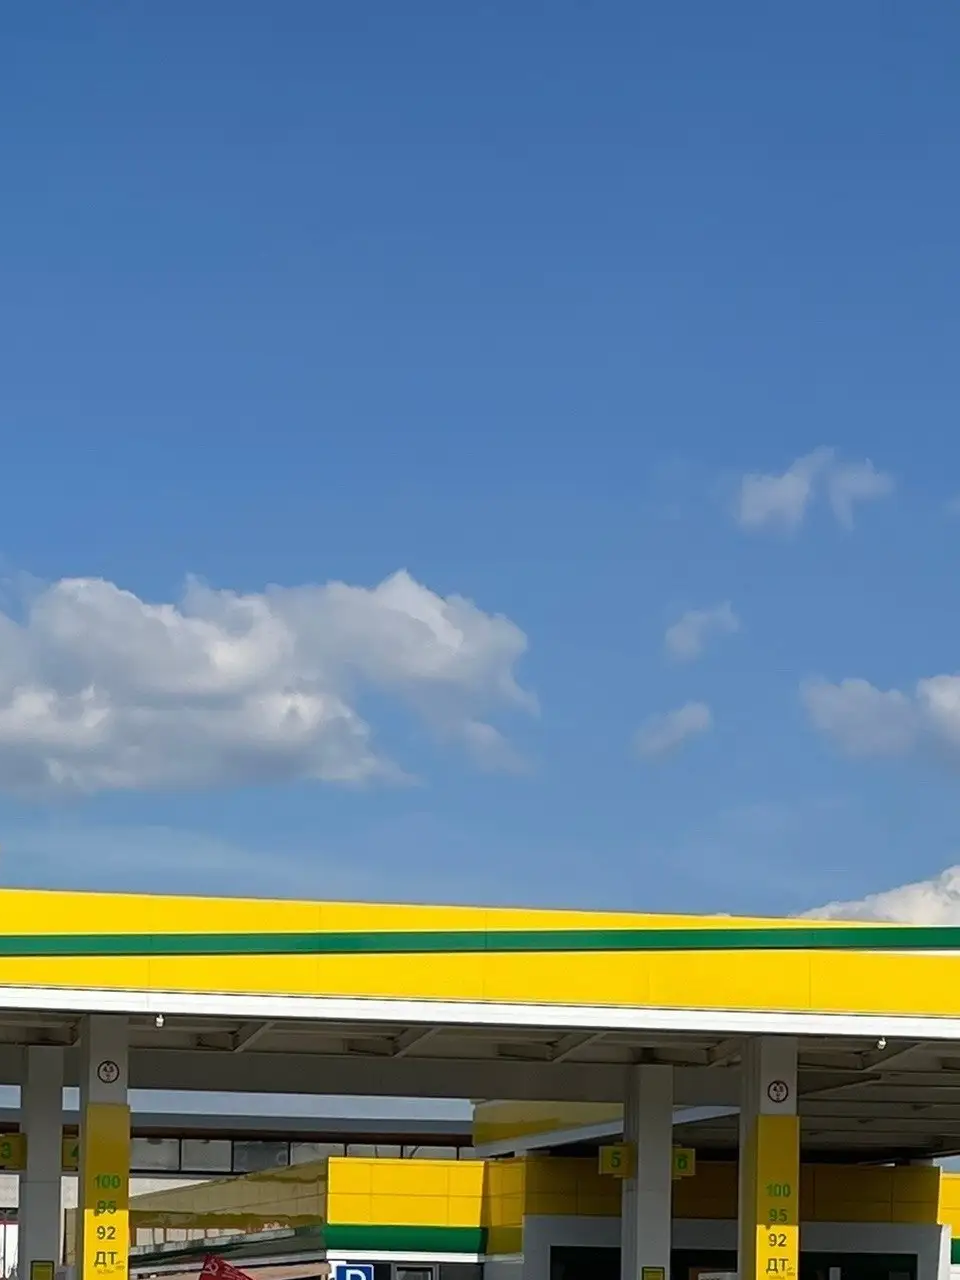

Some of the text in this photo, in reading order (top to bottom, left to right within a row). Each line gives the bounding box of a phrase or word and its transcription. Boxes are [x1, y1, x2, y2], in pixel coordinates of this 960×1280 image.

[0, 1143, 12, 1159] 3
[610, 1151, 622, 1168] 5
[676, 1153, 689, 1170] 6
[94, 1174, 121, 1189] 100
[766, 1184, 791, 1198] 100
[96, 1200, 117, 1215] 95
[768, 1208, 788, 1223] 95
[96, 1226, 116, 1240] 92
[768, 1233, 788, 1247] 92
[93, 1251, 119, 1267] ДТ
[765, 1258, 790, 1275] ДТ
